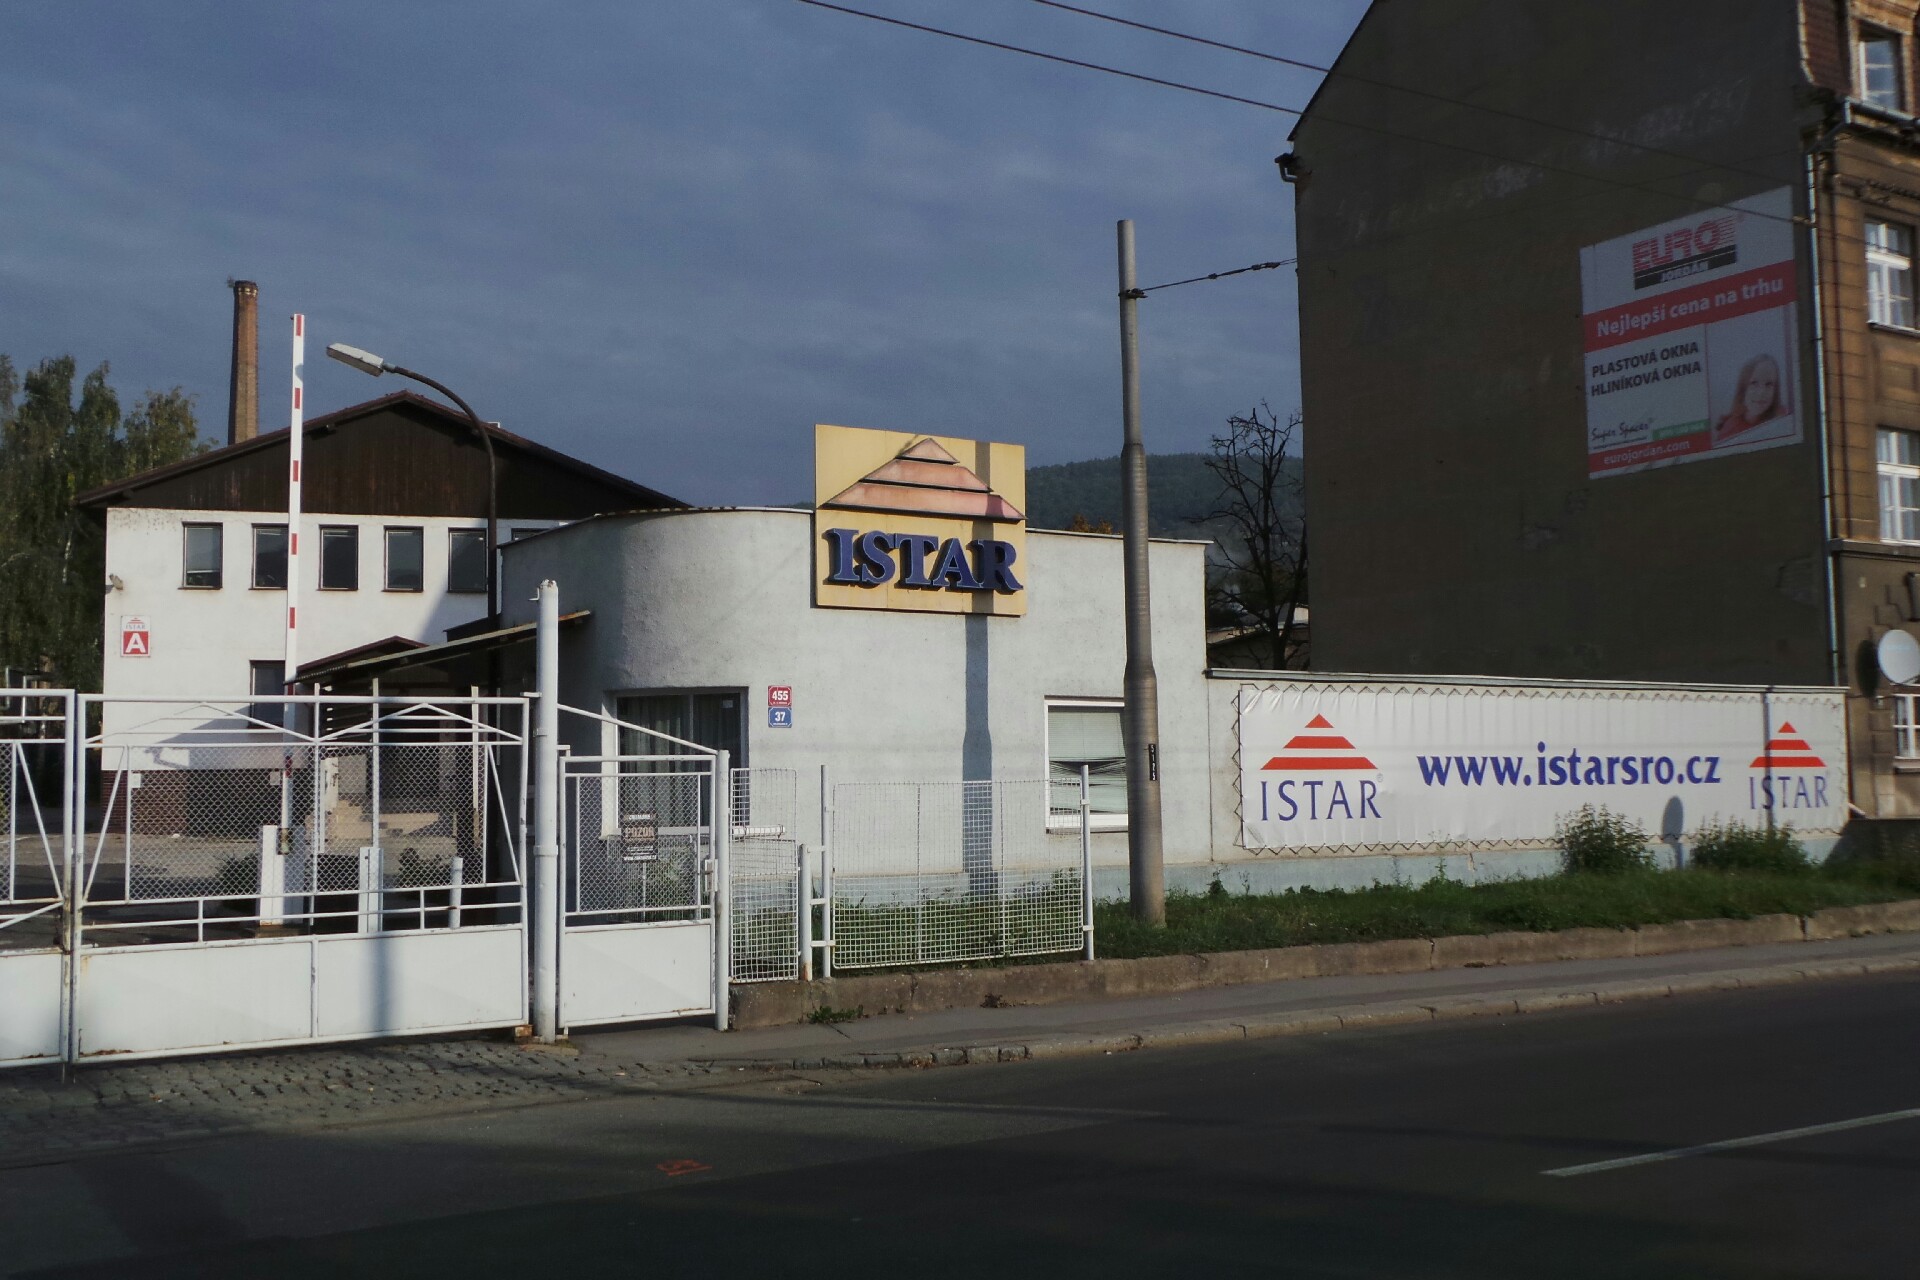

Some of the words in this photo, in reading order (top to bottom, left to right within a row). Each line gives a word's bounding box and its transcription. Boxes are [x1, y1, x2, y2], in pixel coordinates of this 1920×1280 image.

[1632, 220, 1721, 272] EURO
[1597, 304, 1666, 337] Nejlepší
[1670, 297, 1711, 318] cena
[1715, 291, 1738, 307] na
[1742, 278, 1784, 300] trhu
[1591, 349, 1658, 378] PLASTOVÁ
[1660, 341, 1699, 361] OKNA
[1591, 368, 1660, 397] HLINÍKOVÁ
[1662, 361, 1701, 380] OKNA
[1603, 441, 1691, 465] eurojordan.com
[825, 528, 1024, 592] ISTAR
[125, 632, 147, 653] A
[772, 690, 789, 701] 455
[774, 711, 786, 722] 37
[1416, 741, 1721, 787] www.istarsro.cz
[1260, 779, 1383, 822] ISTAR
[1749, 775, 1829, 810] ISTAR
